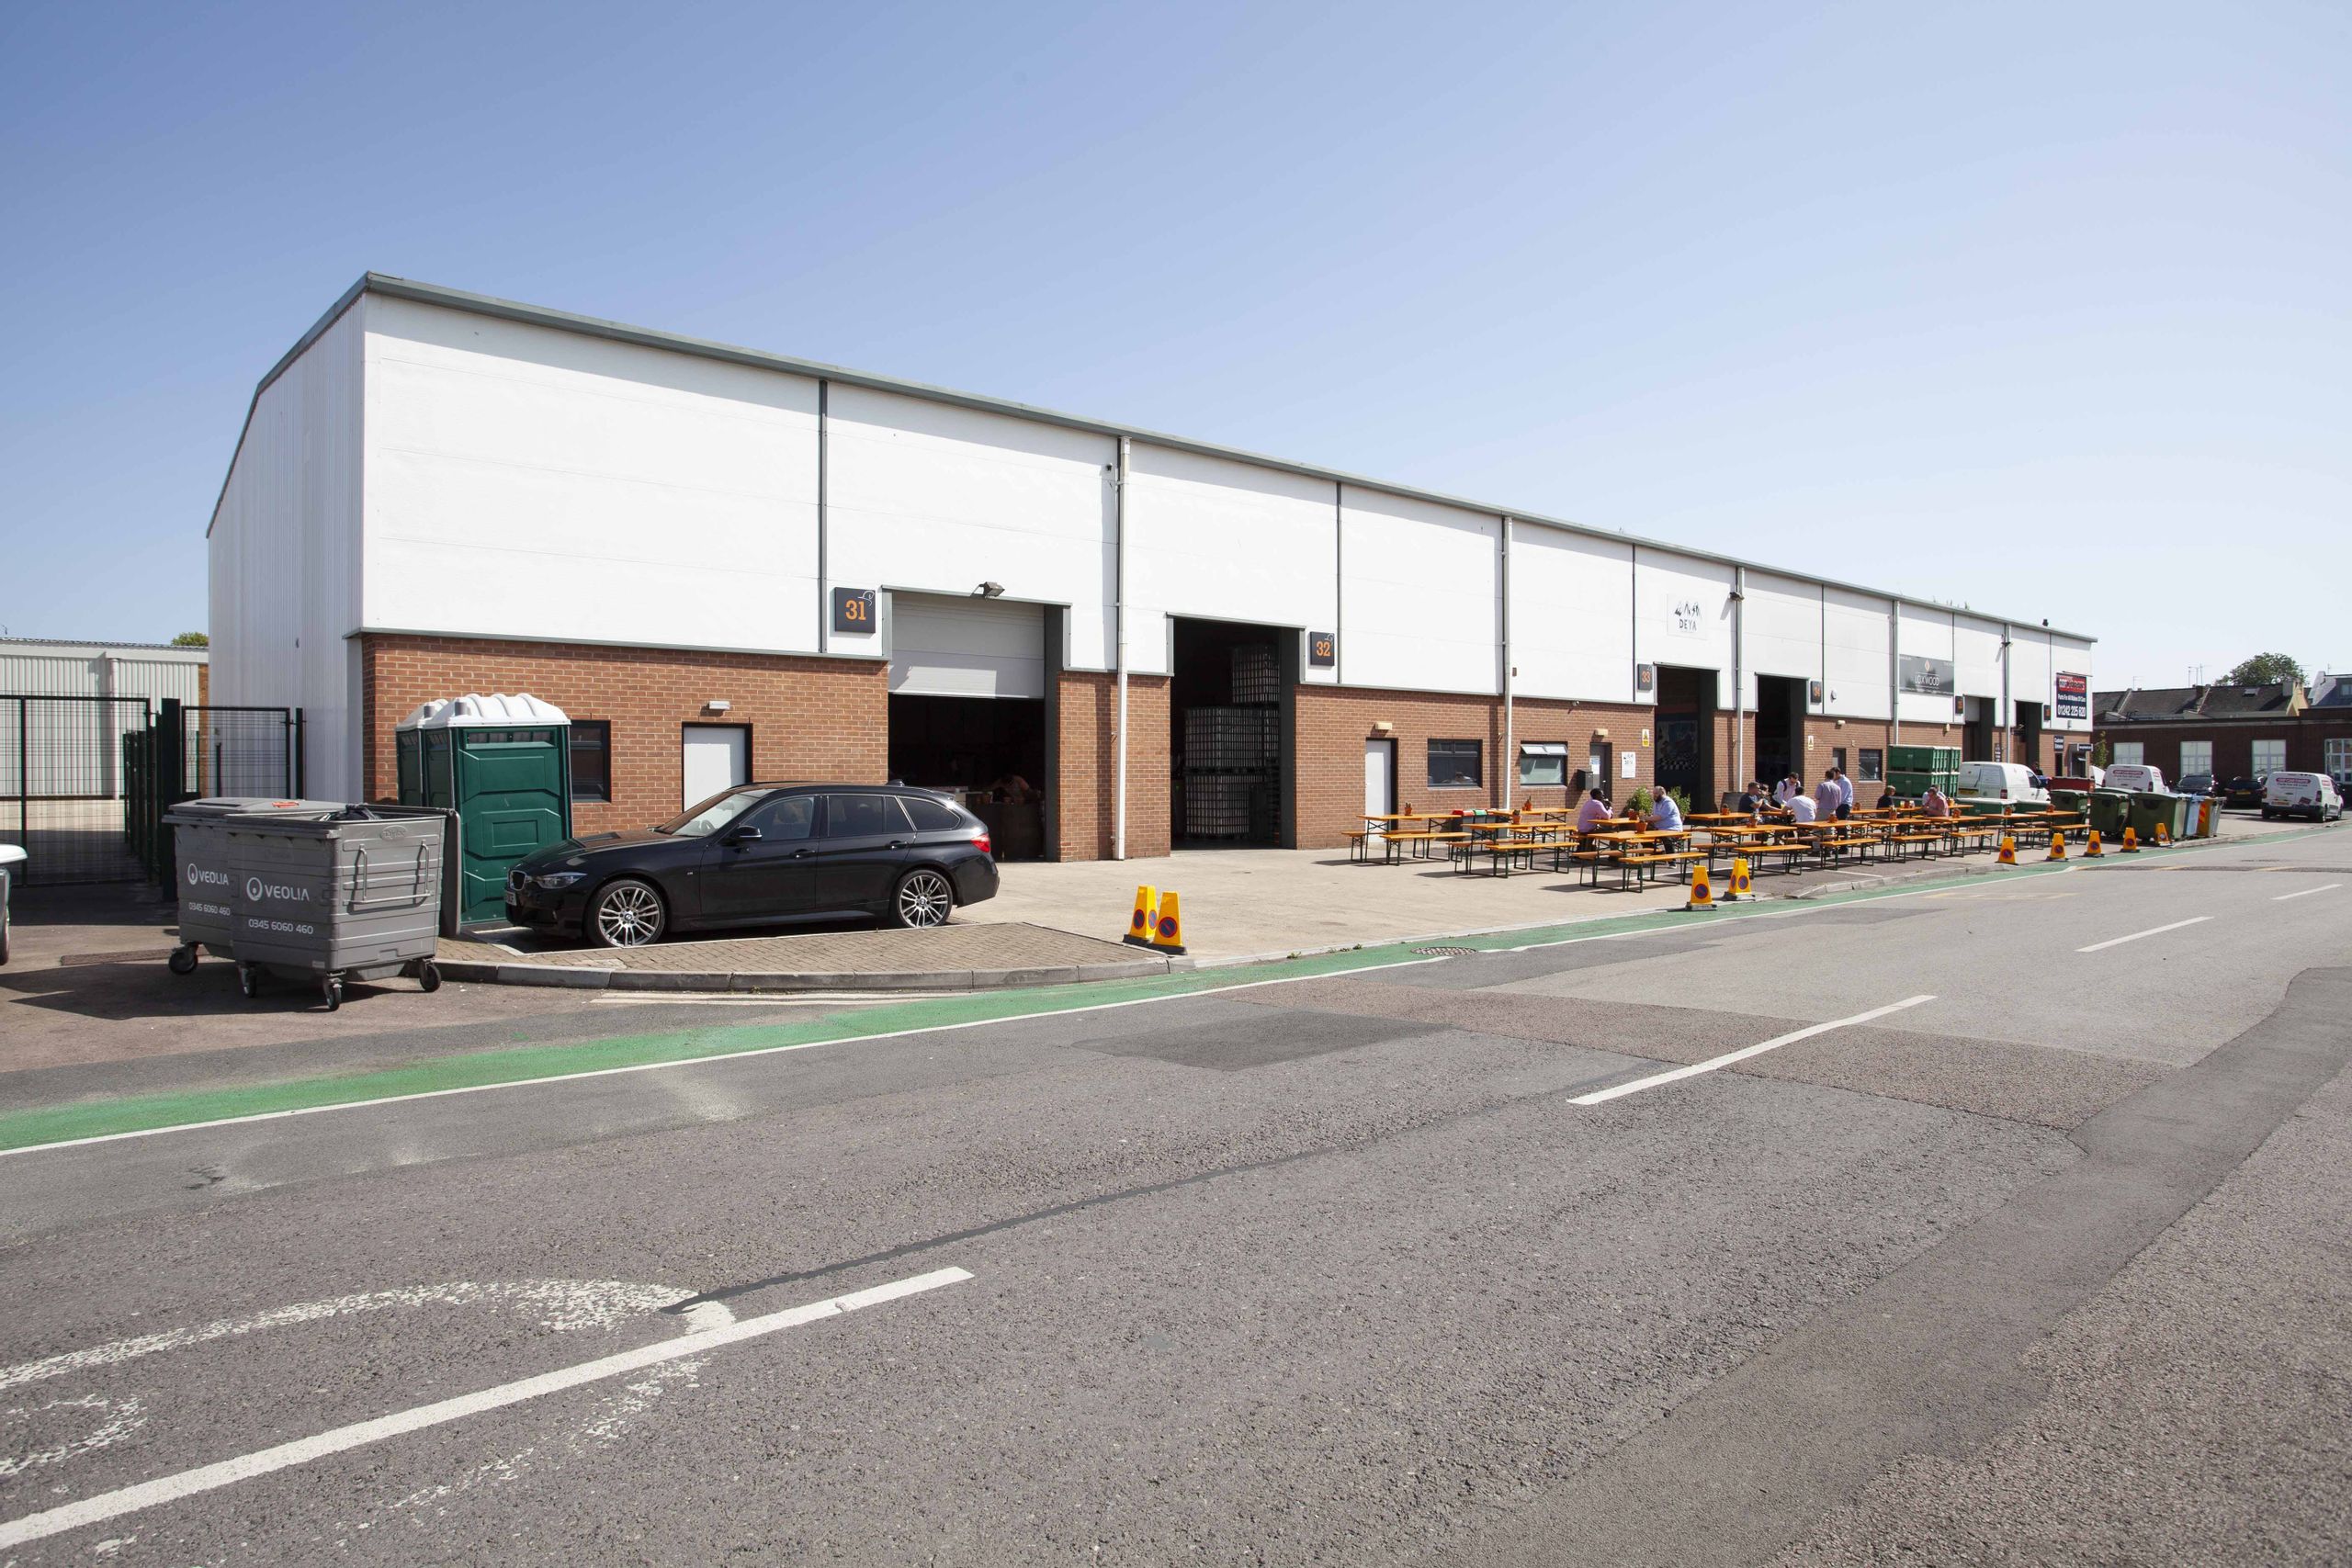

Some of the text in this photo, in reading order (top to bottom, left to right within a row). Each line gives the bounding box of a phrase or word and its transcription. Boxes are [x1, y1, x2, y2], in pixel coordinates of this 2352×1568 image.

[845, 600, 866, 621] 31
[1679, 619, 1697, 631] DEYA
[1316, 640, 1330, 657] 32
[1642, 671, 1651, 682] 33
[199, 870, 229, 886] VEOLIA
[266, 884, 311, 902] VEOLIA
[188, 902, 231, 917] 0345 6060 460
[248, 918, 314, 935] 0345 6060 460
